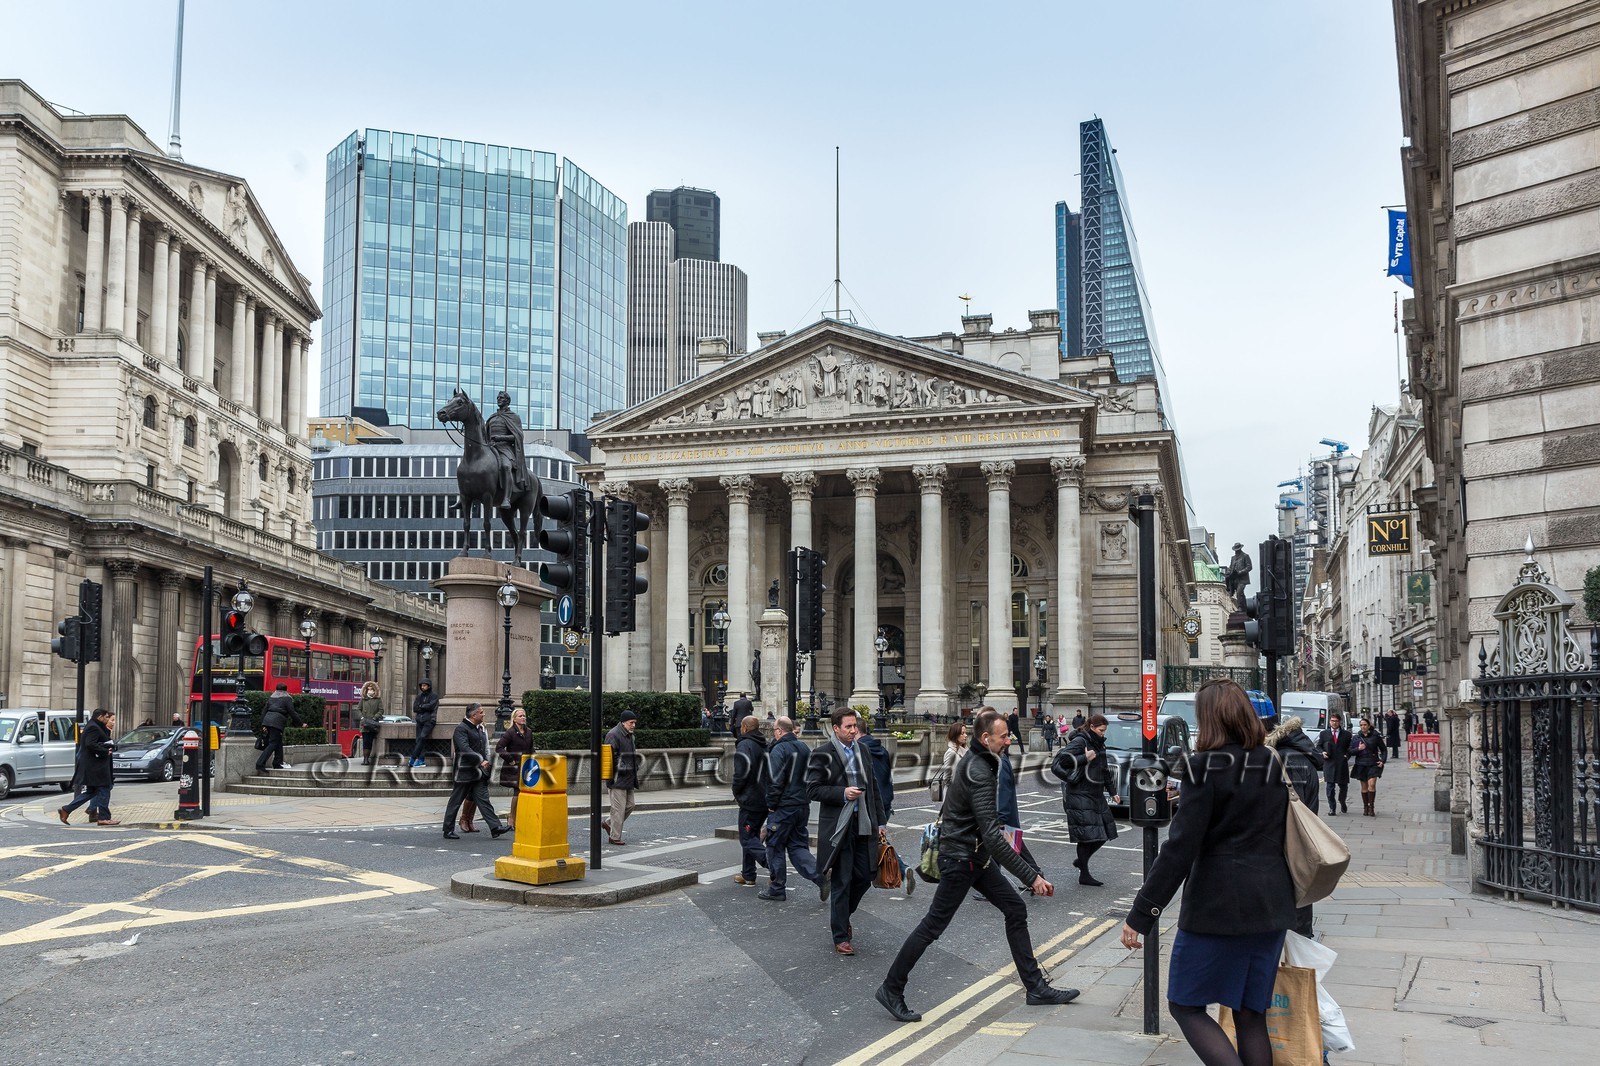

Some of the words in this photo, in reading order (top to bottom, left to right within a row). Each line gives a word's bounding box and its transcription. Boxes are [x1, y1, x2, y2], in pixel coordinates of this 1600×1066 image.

[1395, 218, 1406, 242] Capital
[1394, 242, 1404, 258] VTB
[621, 453, 649, 464] ANNO
[769, 442, 824, 455] CONDITVM
[837, 440, 869, 450] ANNO
[875, 436, 933, 448] VICTORIAE
[954, 434, 971, 444] VIII
[978, 429, 1061, 442] RESTAVRATVM
[1371, 542, 1408, 553] CORNHILL
[510, 632, 533, 642] ELLINGTON
[1145, 678, 1153, 703] butts
[1146, 710, 1155, 731] gum
